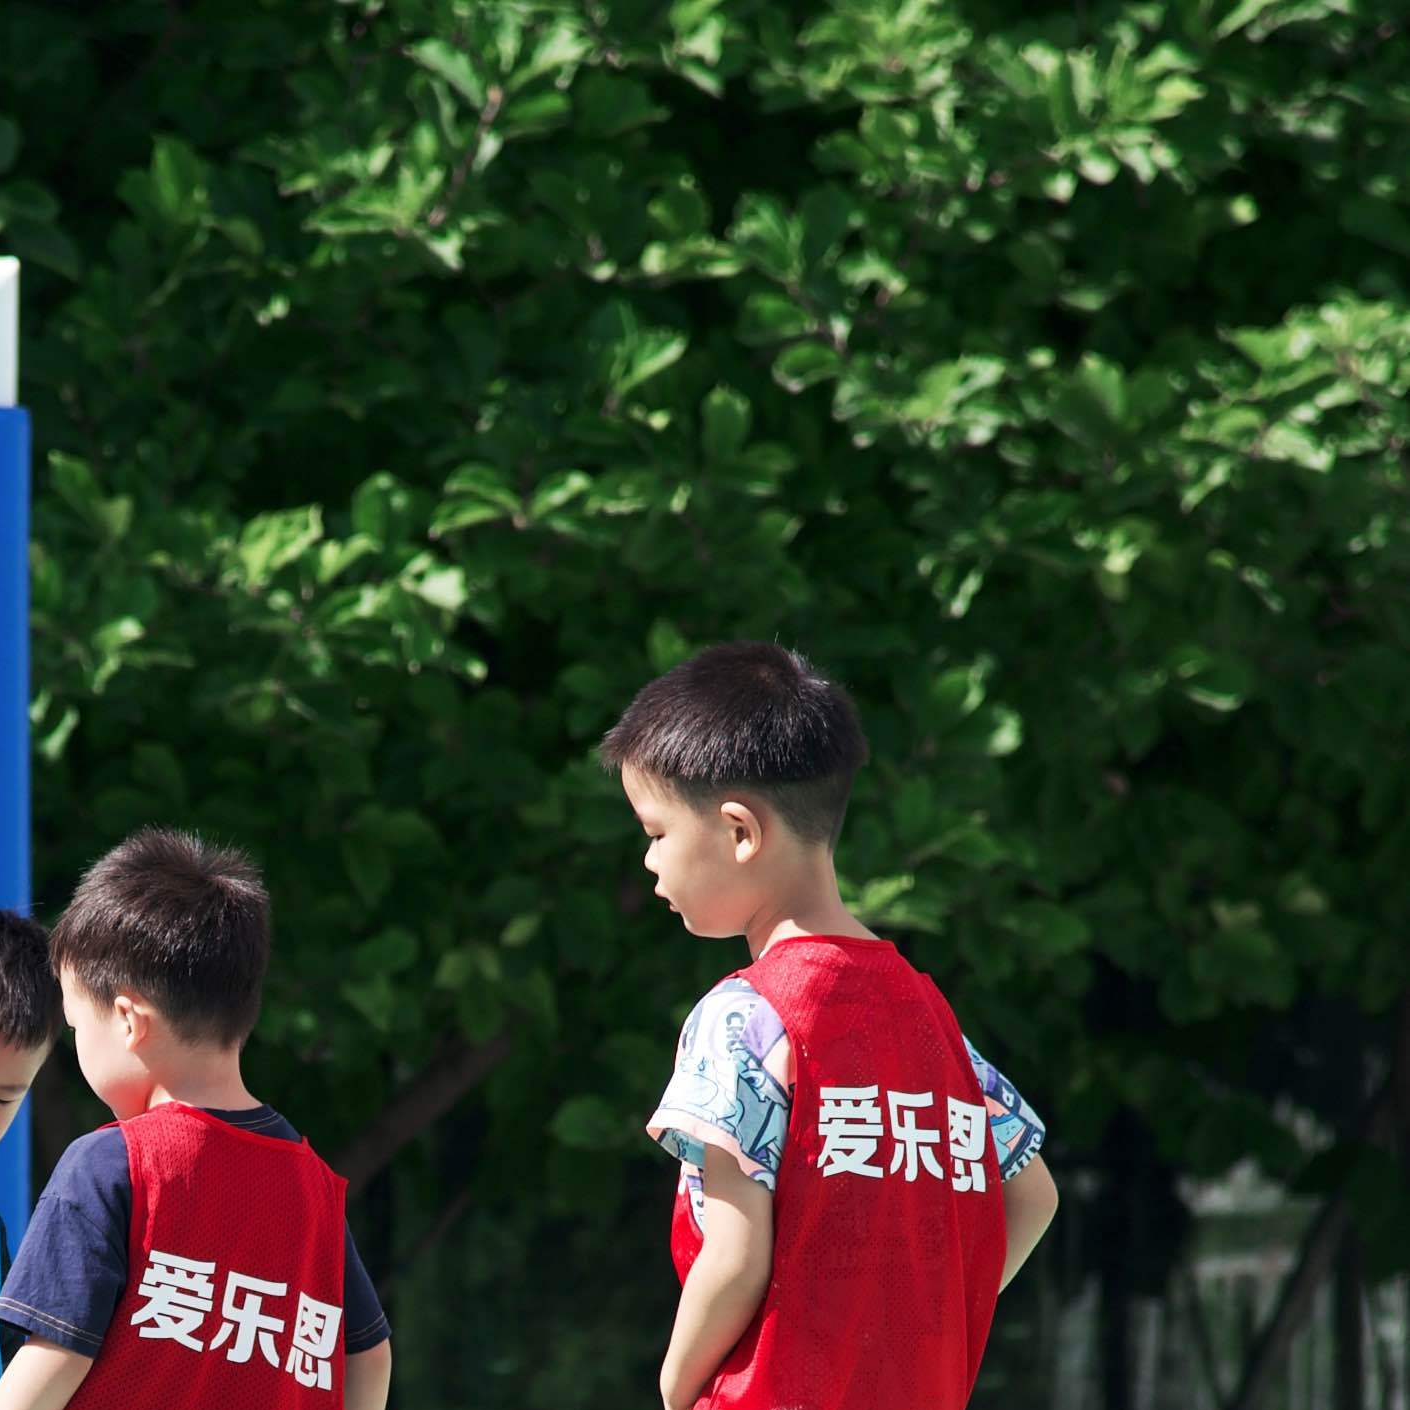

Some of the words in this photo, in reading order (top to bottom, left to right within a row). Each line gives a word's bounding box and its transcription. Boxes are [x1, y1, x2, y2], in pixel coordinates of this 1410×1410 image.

[817, 1084, 987, 1193] 爱乐恩
[130, 1249, 344, 1391] 爱乐恩
